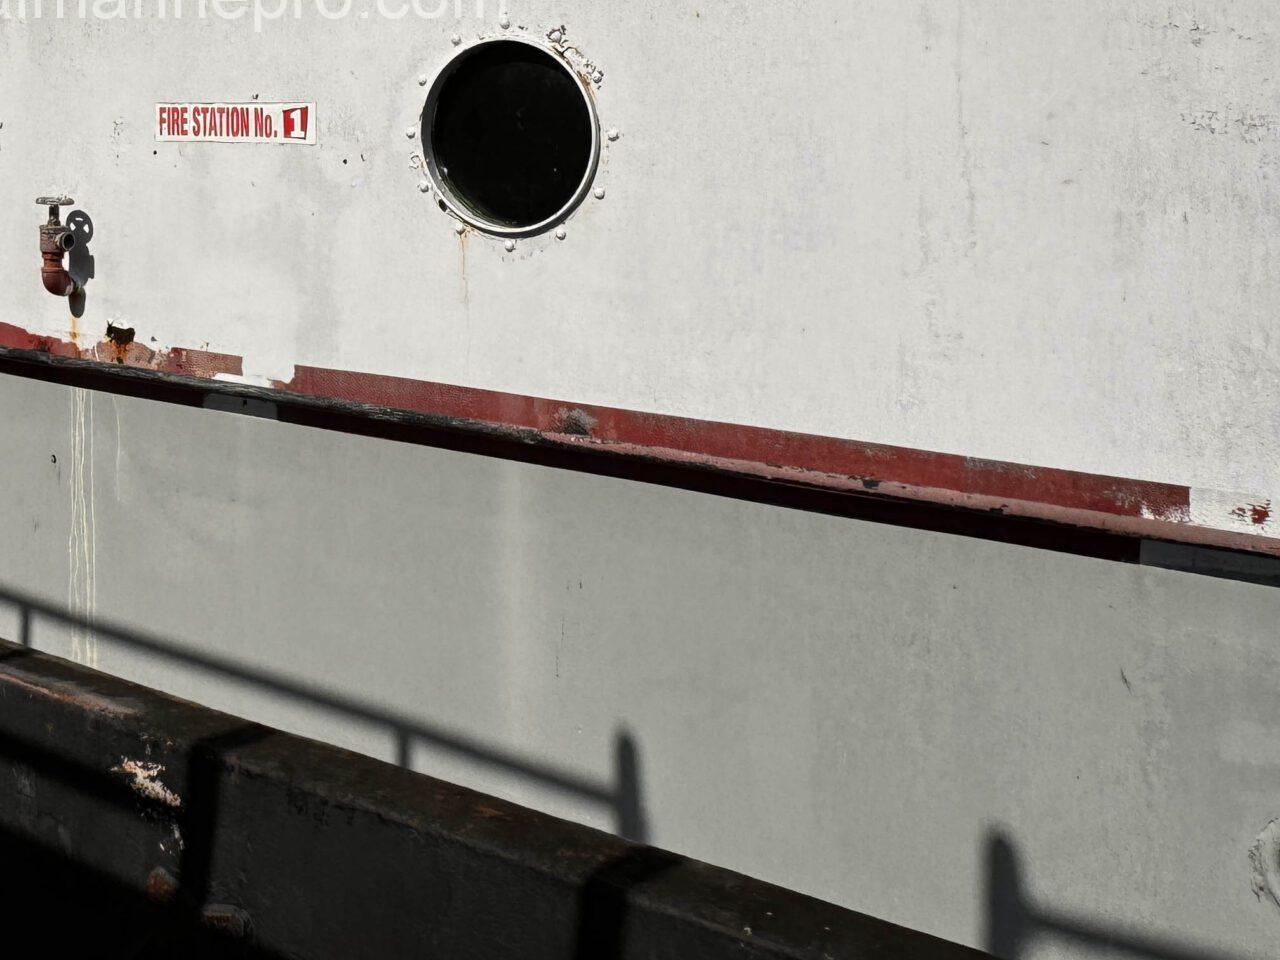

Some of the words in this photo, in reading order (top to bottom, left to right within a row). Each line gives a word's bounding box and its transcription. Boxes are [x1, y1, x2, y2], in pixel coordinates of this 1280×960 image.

[159, 106, 188, 136] FIRE
[192, 106, 249, 137] STATION
[254, 107, 278, 138] No.
[289, 108, 306, 138] 1
